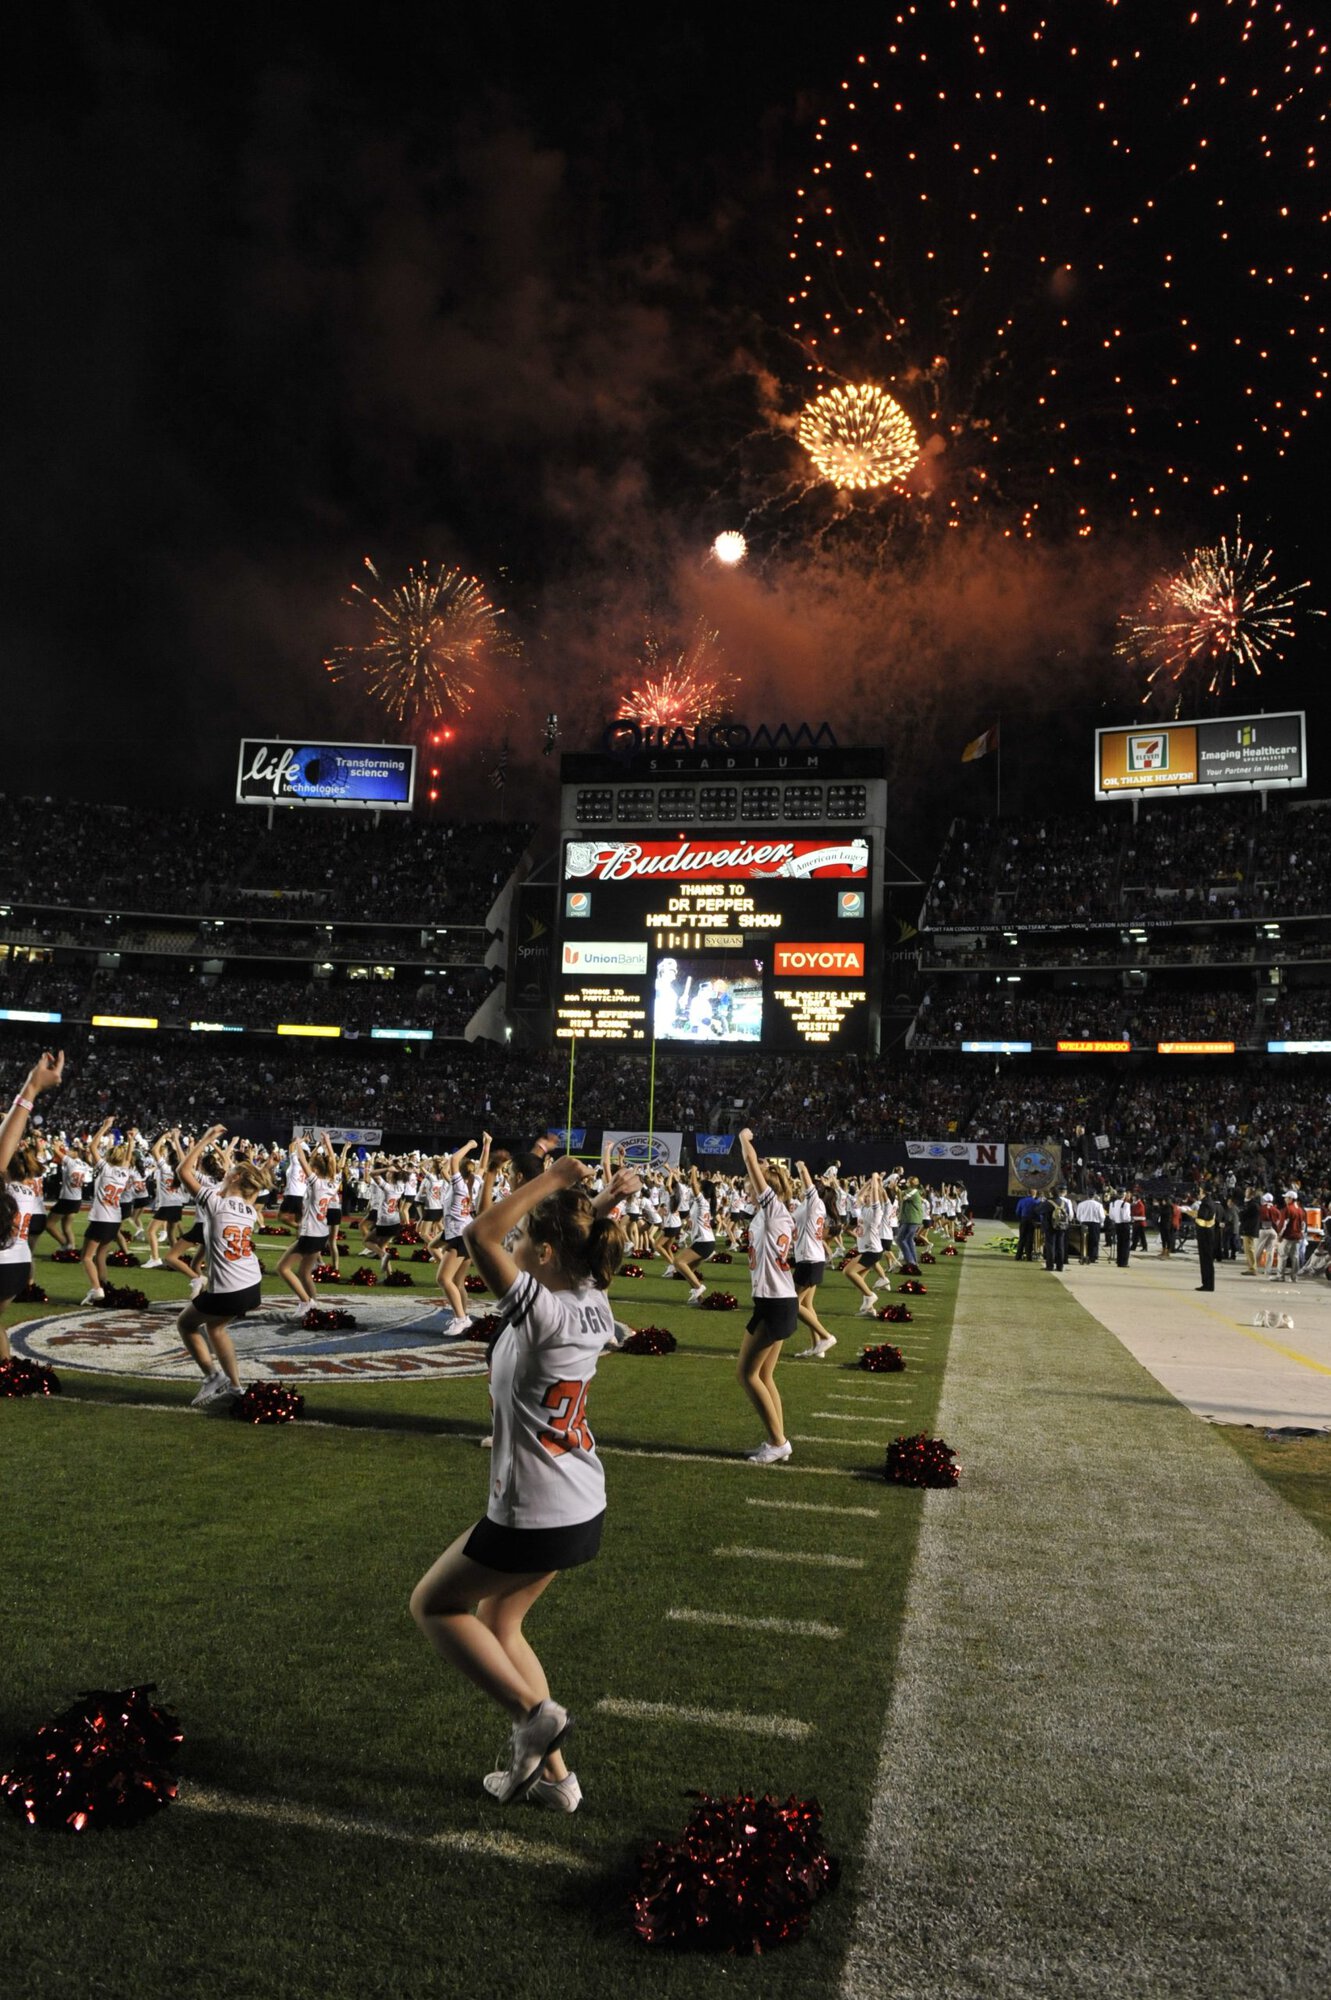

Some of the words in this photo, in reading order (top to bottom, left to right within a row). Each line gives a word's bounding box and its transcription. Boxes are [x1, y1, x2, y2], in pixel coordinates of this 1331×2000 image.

[603, 719, 837, 767] QUALCOMM
[1201, 750, 1241, 761] Imaging
[1243, 745, 1297, 757] Healthcare
[335, 757, 405, 771] Transforming
[650, 756, 819, 769] STADIUM
[242, 746, 301, 795] life
[350, 768, 389, 778] science
[1206, 768, 1223, 776] Your
[1224, 766, 1252, 775] Partner
[1264, 763, 1289, 772] Health
[1121, 775, 1154, 784] THANK
[592, 840, 794, 880] Budweiser
[796, 854, 837, 872] American
[840, 852, 865, 862] Lager
[680, 884, 725, 896] THANKS
[729, 884, 745, 896] TO
[668, 898, 690, 911] DR
[696, 898, 754, 911] PEPPER
[646, 914, 729, 927] HALFTIME
[738, 914, 782, 927] SHOW
[705, 937, 743, 945] SYCUAN
[518, 945, 548, 959] Sprint
[779, 952, 860, 968] TOYOTA
[613, 988, 624, 996] TO
[774, 991, 792, 1000] THE
[795, 991, 837, 1000] PACIFIC
[841, 991, 866, 1001] LIFE
[558, 1009, 592, 1018] THOMAS
[595, 1010, 646, 1019] JEFFERSON
[597, 1020, 631, 1029] SCHOOL
[797, 1021, 840, 1031] KRISTIN
[1059, 1042, 1093, 1050] WELLS
[1095, 1042, 1129, 1050] FARGO
[303, 1128, 317, 1145] A
[621, 1138, 647, 1147] PACIFIC
[976, 1145, 998, 1165] N
